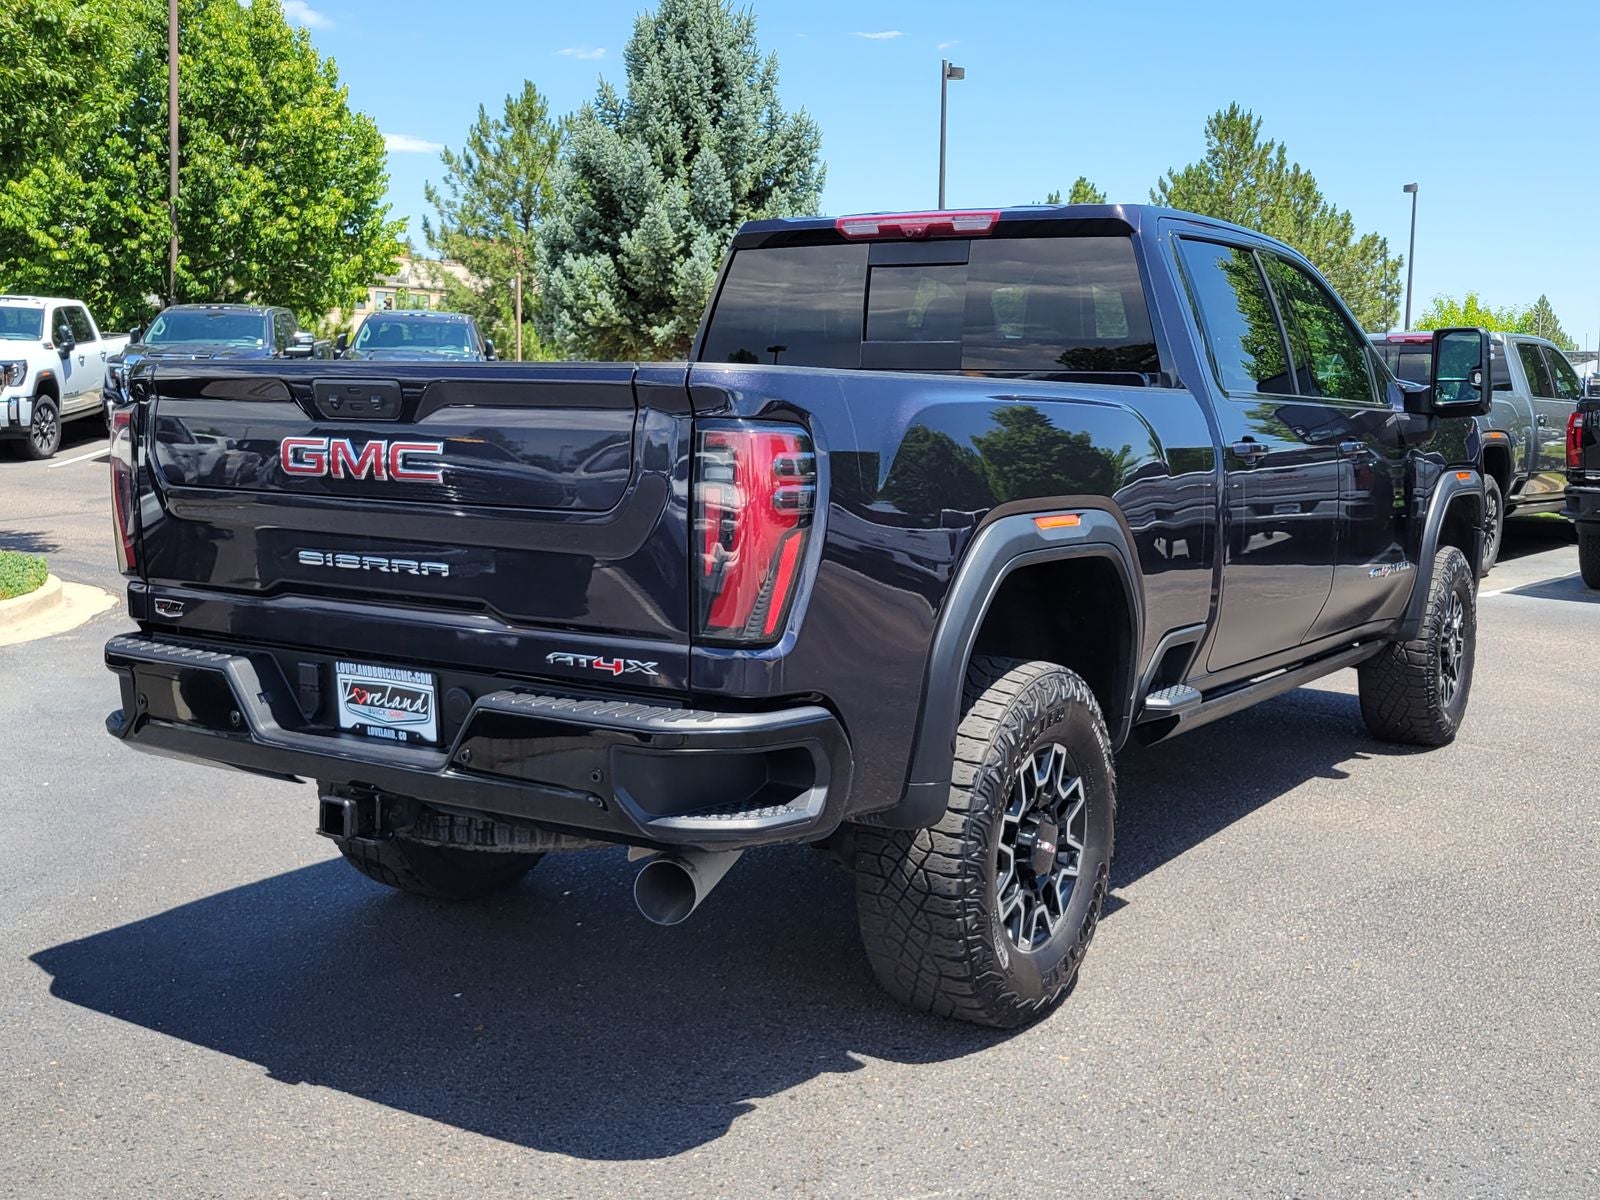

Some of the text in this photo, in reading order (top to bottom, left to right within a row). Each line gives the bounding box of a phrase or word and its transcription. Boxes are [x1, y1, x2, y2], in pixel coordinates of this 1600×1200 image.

[280, 436, 444, 484] GMC
[298, 550, 450, 577] SIERRA
[335, 661, 432, 684] LOVELANDBUICKGMC.COM
[545, 651, 659, 677] AT4X
[398, 731, 407, 740] CO
